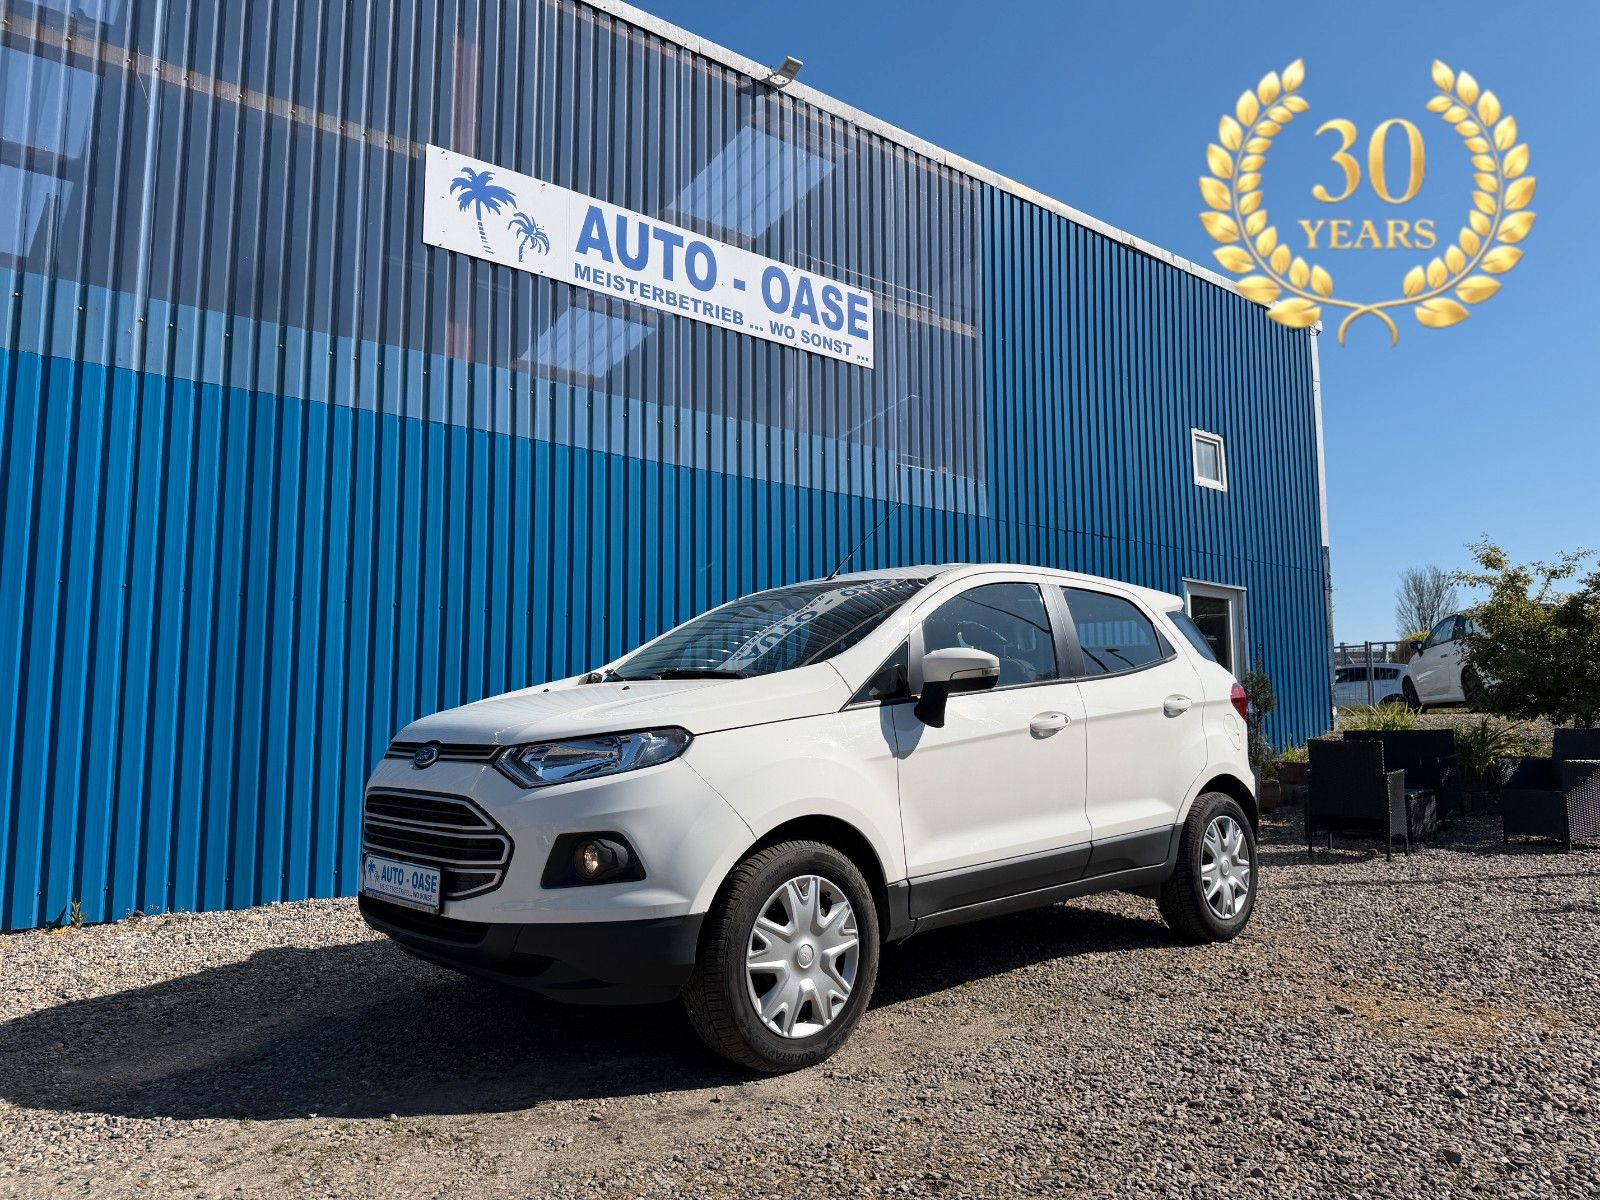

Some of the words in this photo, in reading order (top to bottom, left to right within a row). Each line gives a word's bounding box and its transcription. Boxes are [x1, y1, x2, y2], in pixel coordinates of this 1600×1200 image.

[574, 262, 744, 326] MEISTERBETRIEB
[769, 320, 796, 340] WO
[801, 330, 852, 356] SONST
[575, 204, 717, 292] AUTO
[733, 278, 746, 291] -
[761, 265, 869, 340] OASE
[381, 864, 404, 885] AUTO
[412, 871, 437, 893] OASE
